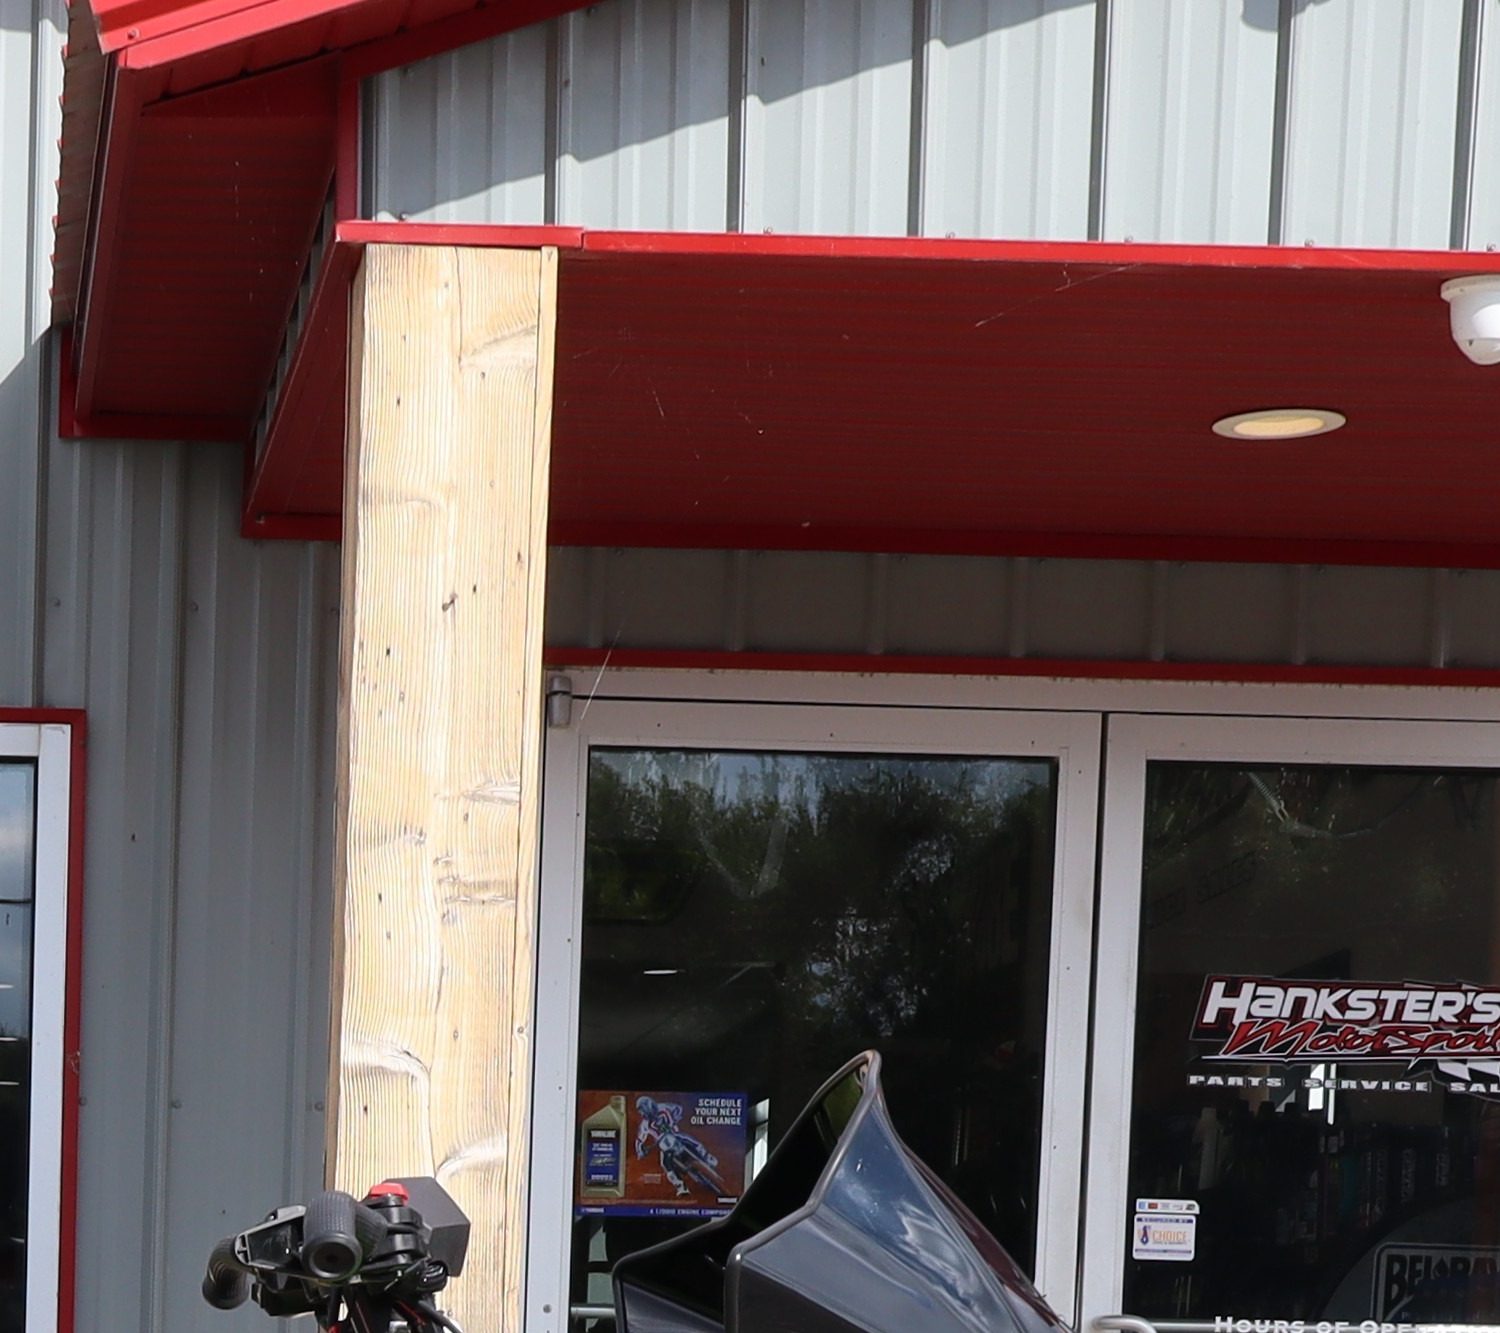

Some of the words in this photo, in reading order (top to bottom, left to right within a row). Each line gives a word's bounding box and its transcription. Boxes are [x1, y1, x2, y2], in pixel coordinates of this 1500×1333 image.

[1188, 1075, 1285, 1088] PARTS
[1304, 1078, 1430, 1093] SERVICE
[698, 1098, 742, 1108] SCHEDULE
[695, 1108, 717, 1116] YOUR
[719, 1108, 742, 1117] NEXT
[691, 1116, 704, 1125] OIL
[706, 1116, 742, 1126] CHANGE
